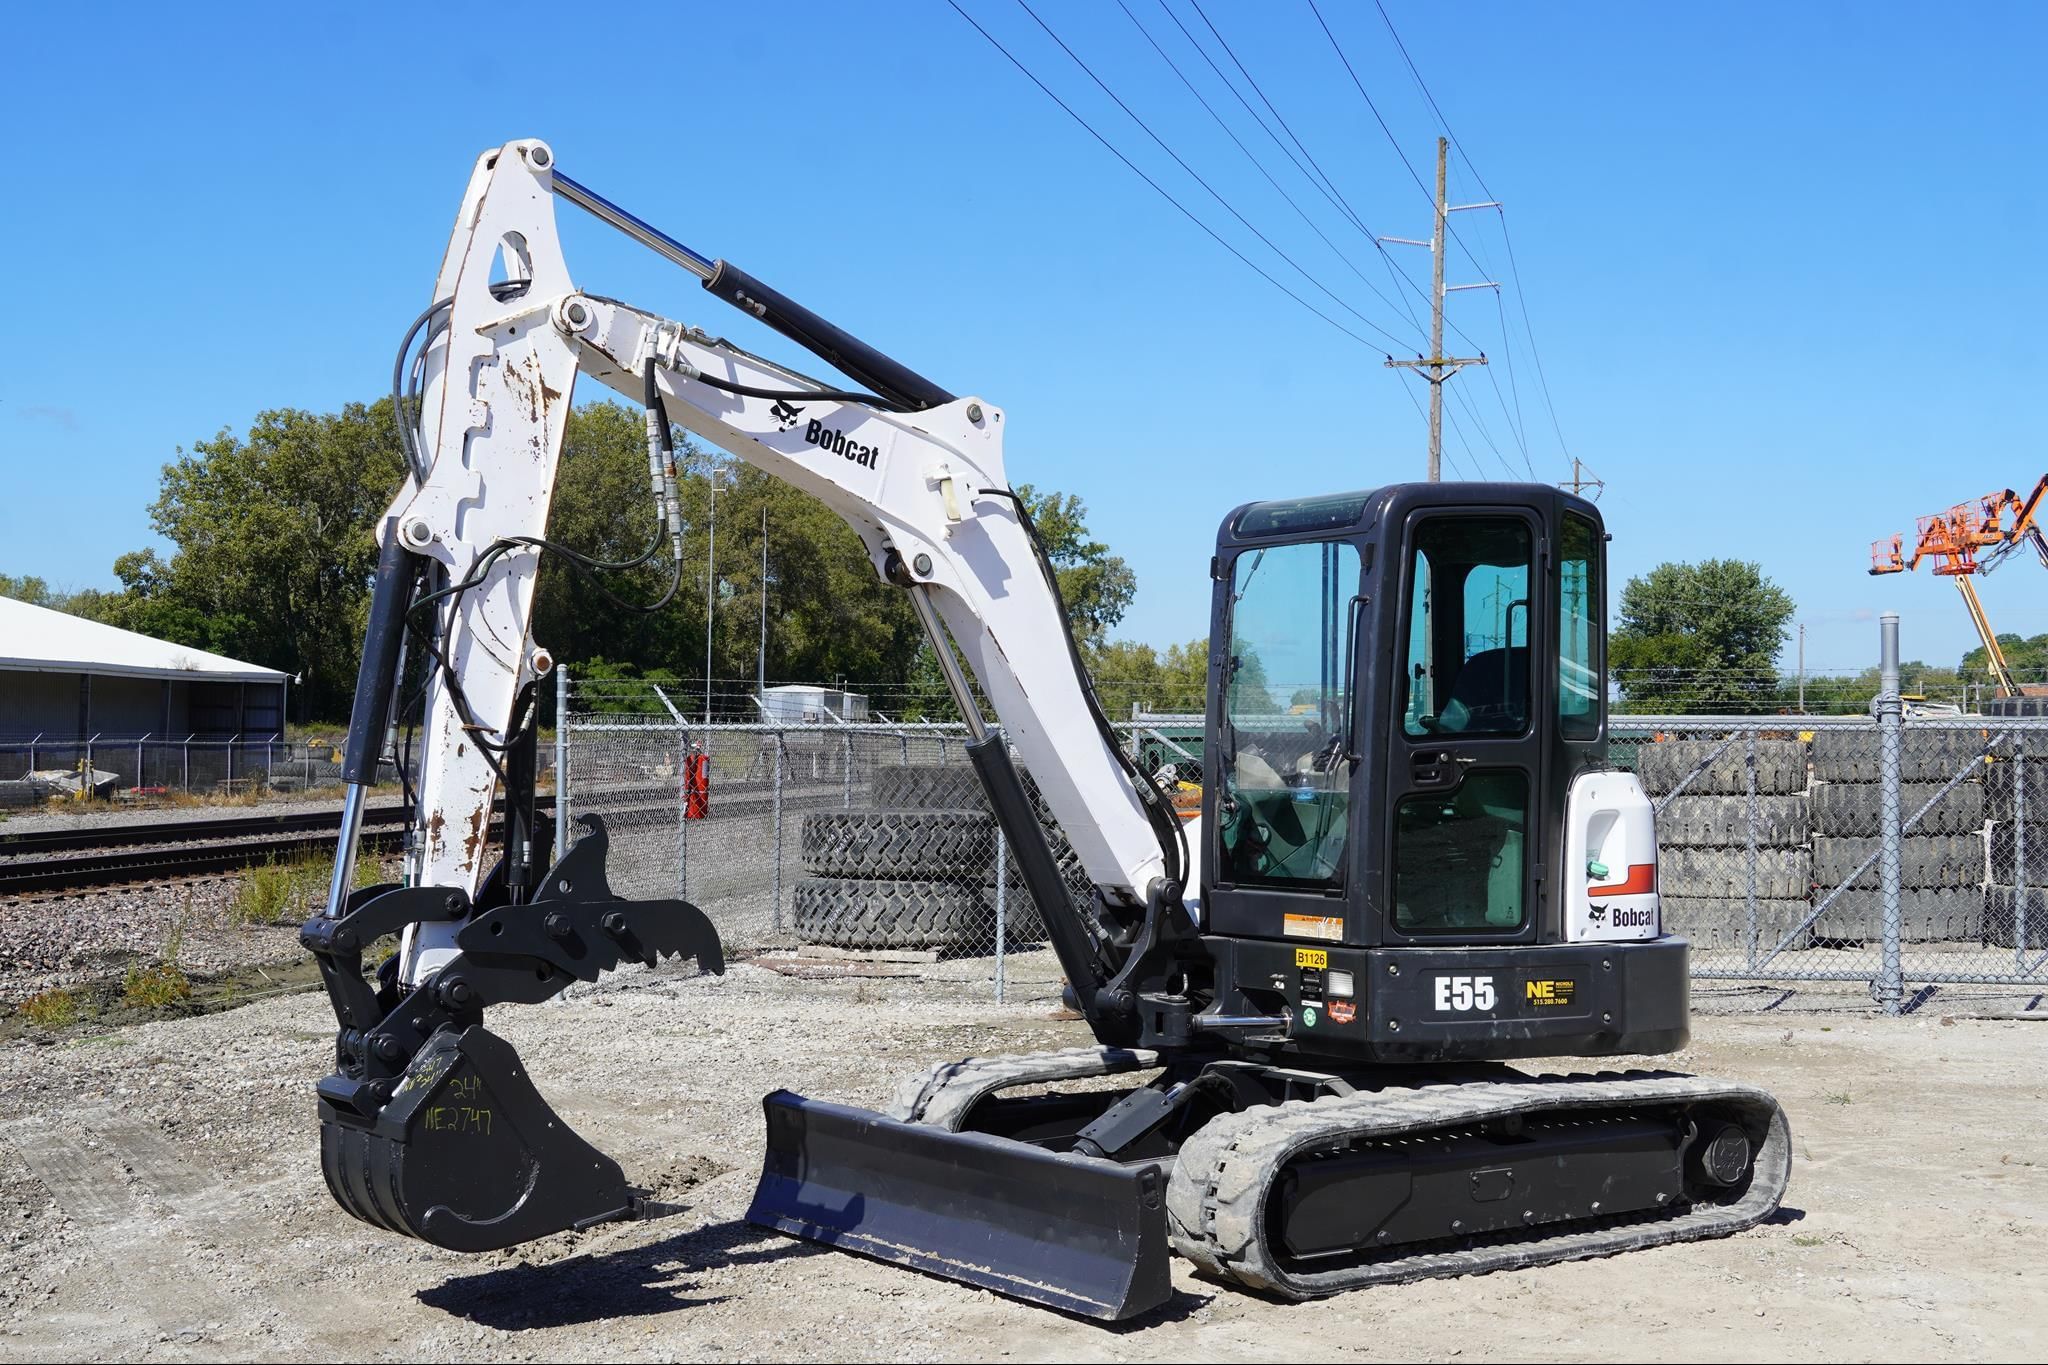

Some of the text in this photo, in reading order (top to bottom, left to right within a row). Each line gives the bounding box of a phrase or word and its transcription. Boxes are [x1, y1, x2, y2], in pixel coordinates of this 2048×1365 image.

[805, 418, 879, 471] Bobcat
[1613, 907, 1654, 927] Bobcat
[1298, 952, 1325, 965] B1126
[1435, 976, 1495, 1011] E55
[1527, 981, 1555, 998] NE
[425, 1107, 491, 1135] NE2747
